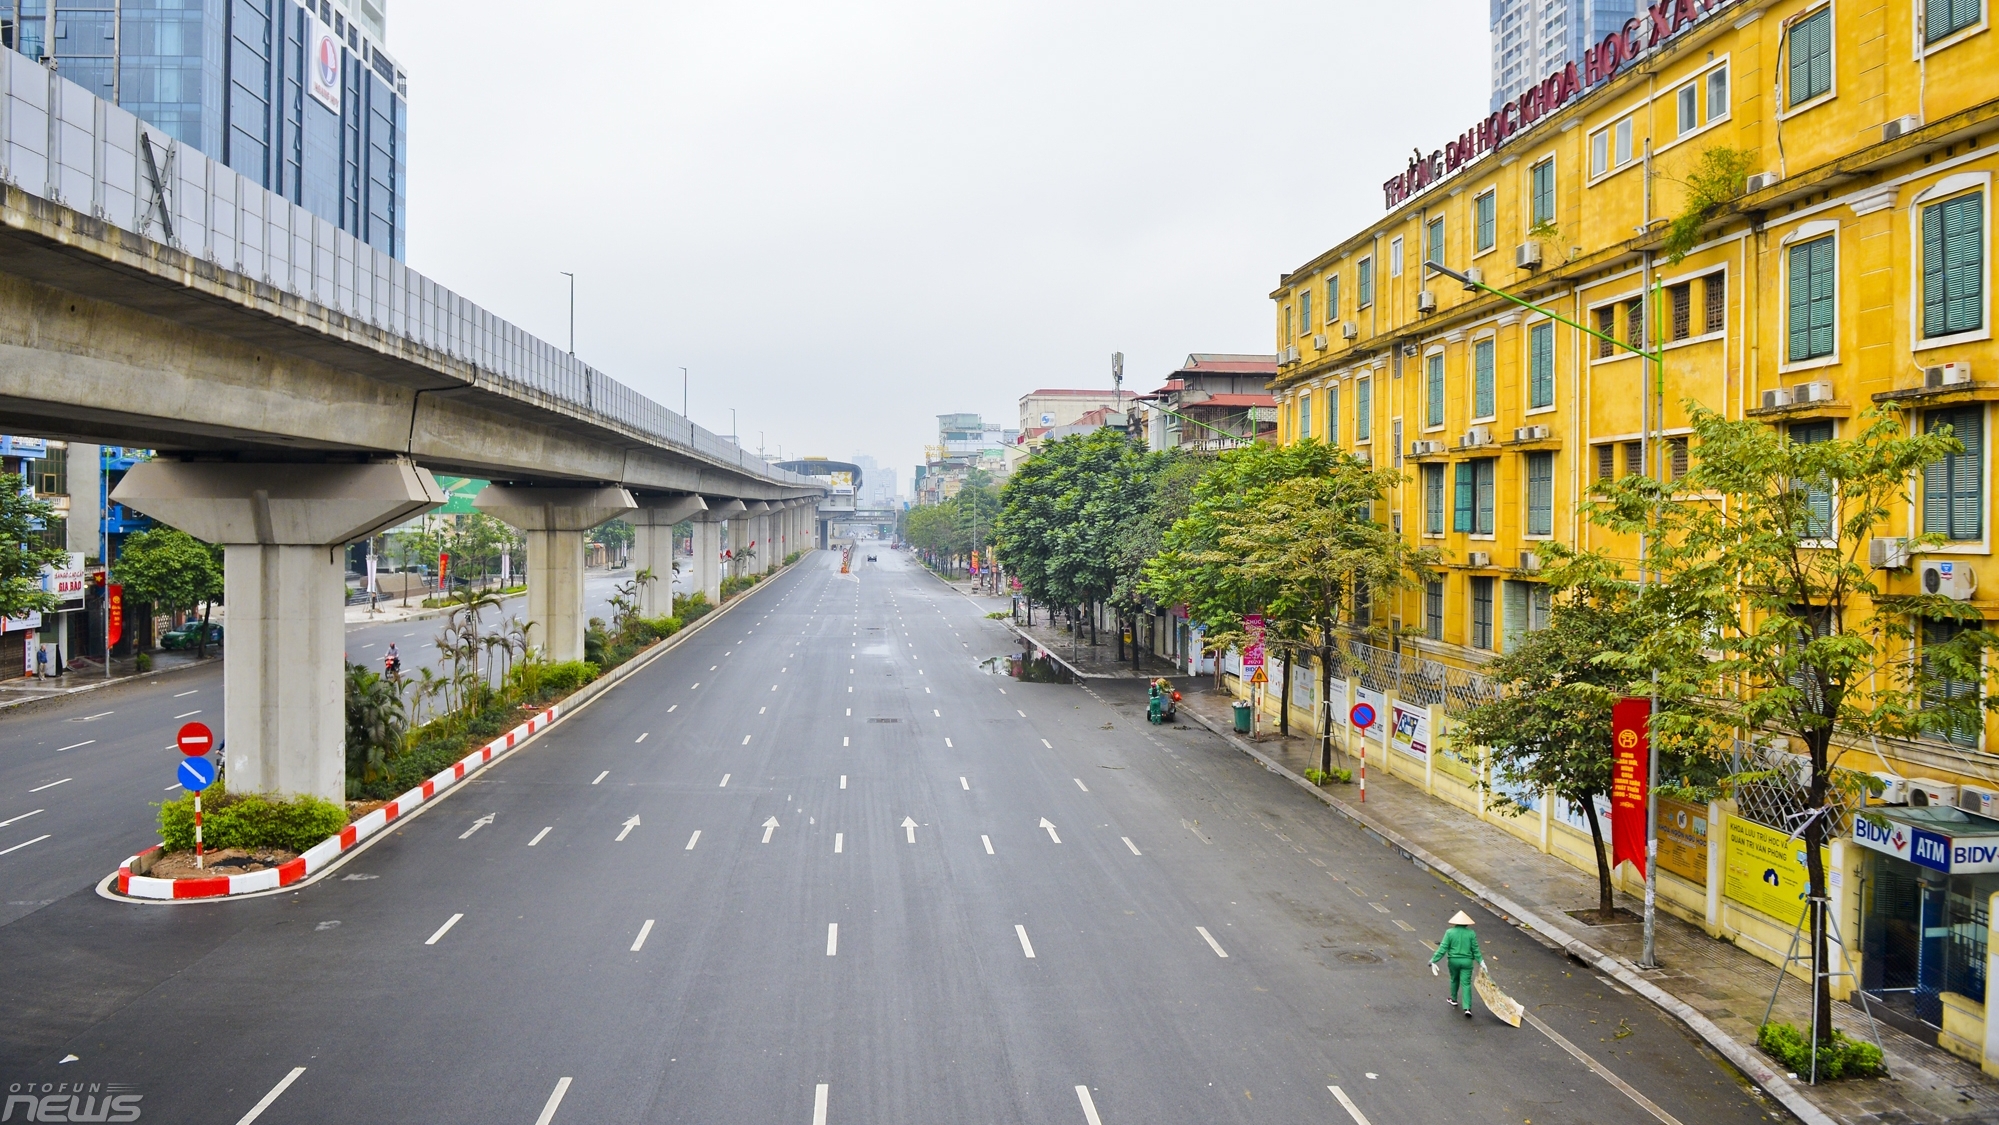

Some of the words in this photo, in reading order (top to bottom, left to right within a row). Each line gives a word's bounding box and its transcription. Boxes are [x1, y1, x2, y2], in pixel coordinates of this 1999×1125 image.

[1446, 128, 1475, 172] ĐẠI
[1477, 102, 1518, 153] HỌC
[1519, 60, 1581, 128] KHOA
[1584, 17, 1641, 87] HỌC
[58, 581, 68, 592] GIA
[69, 578, 82, 592] BẢO
[1730, 822, 1744, 834] KHOA
[1745, 828, 1756, 839] LƯU
[1757, 830, 1767, 842] TRỮ
[1769, 835, 1780, 848] HỌC
[1781, 840, 1788, 850] VÀ
[1856, 818, 1891, 845] BIDV
[1731, 833, 1745, 845] QUẢN
[1746, 838, 1754, 851] TRỊ
[1756, 841, 1767, 854] VĂN
[1767, 847, 1787, 861] PHÒNG
[1916, 837, 1944, 864] ATM
[1954, 846, 1997, 864] BIDV
